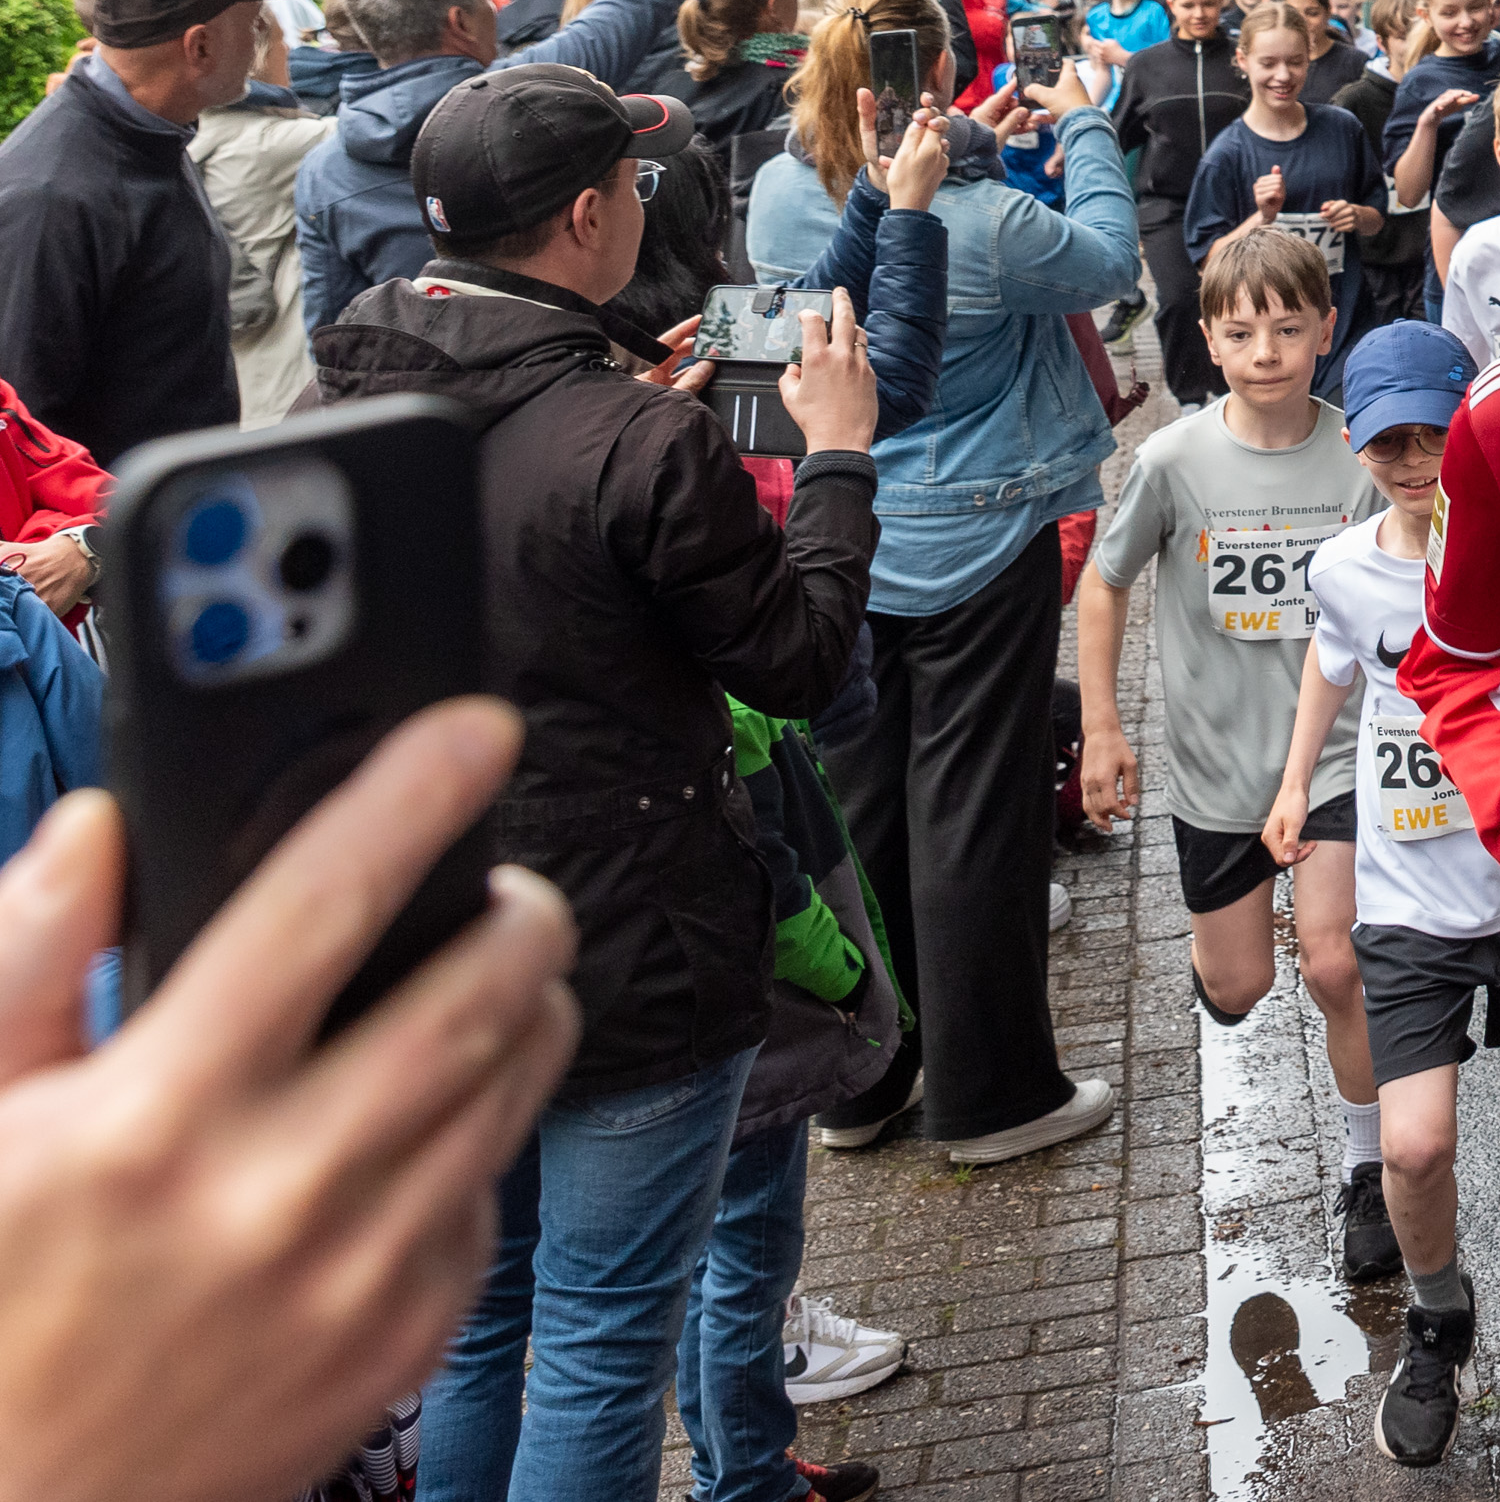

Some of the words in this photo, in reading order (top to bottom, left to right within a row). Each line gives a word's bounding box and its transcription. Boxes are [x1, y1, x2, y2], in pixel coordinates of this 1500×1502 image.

[1204, 507, 1268, 521] Everstener
[1271, 502, 1344, 516] Brunnenlauf
[1217, 540, 1283, 550] Everstener
[1211, 549, 1317, 596] 261
[1270, 597, 1306, 608] Jonte
[1224, 611, 1282, 631] EWE
[1377, 726, 1421, 738] Eversten
[1376, 741, 1443, 789] 26
[1430, 788, 1463, 802] Jona
[1393, 803, 1449, 831] EWE
